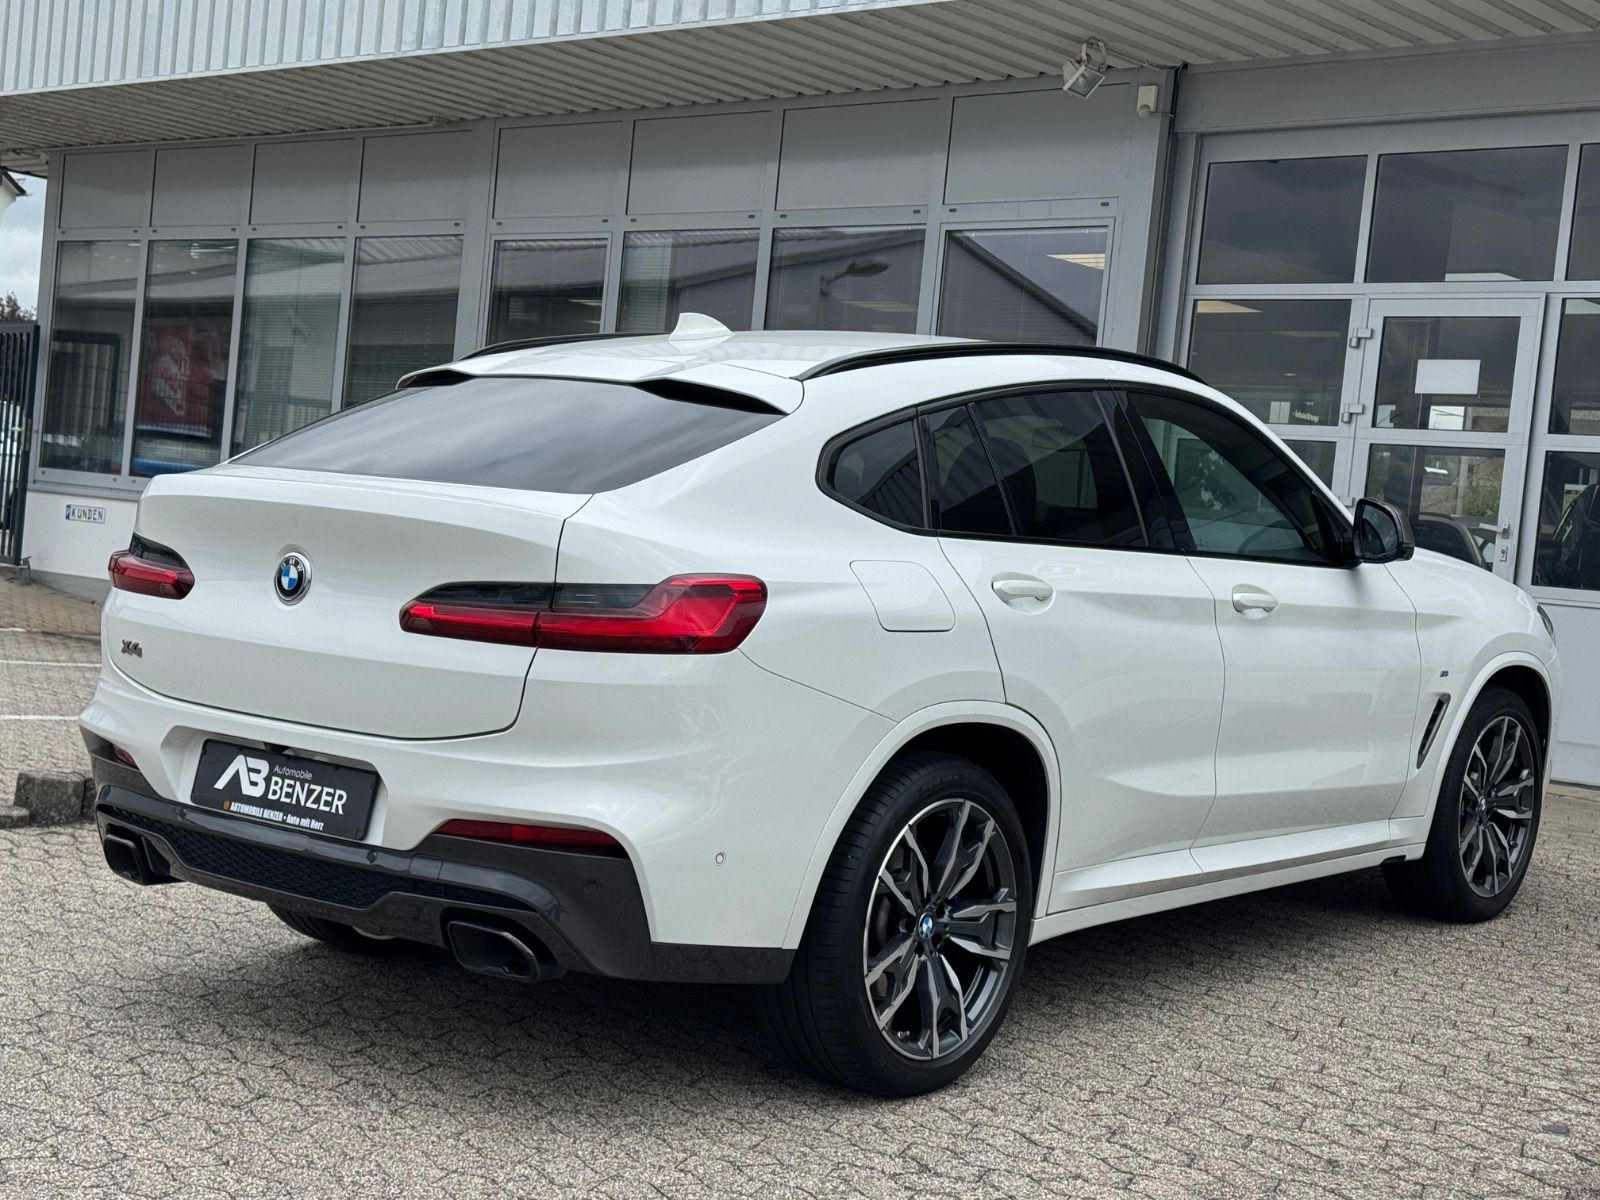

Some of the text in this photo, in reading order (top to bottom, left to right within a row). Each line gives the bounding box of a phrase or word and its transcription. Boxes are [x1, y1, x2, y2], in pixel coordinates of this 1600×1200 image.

[72, 507, 104, 521] KUNDEN
[213, 754, 270, 798] AB
[273, 765, 312, 780] Automobile
[268, 776, 347, 814] BENZER
[230, 802, 324, 830] AUTOMOBILE BENZER Auto mit Herz
